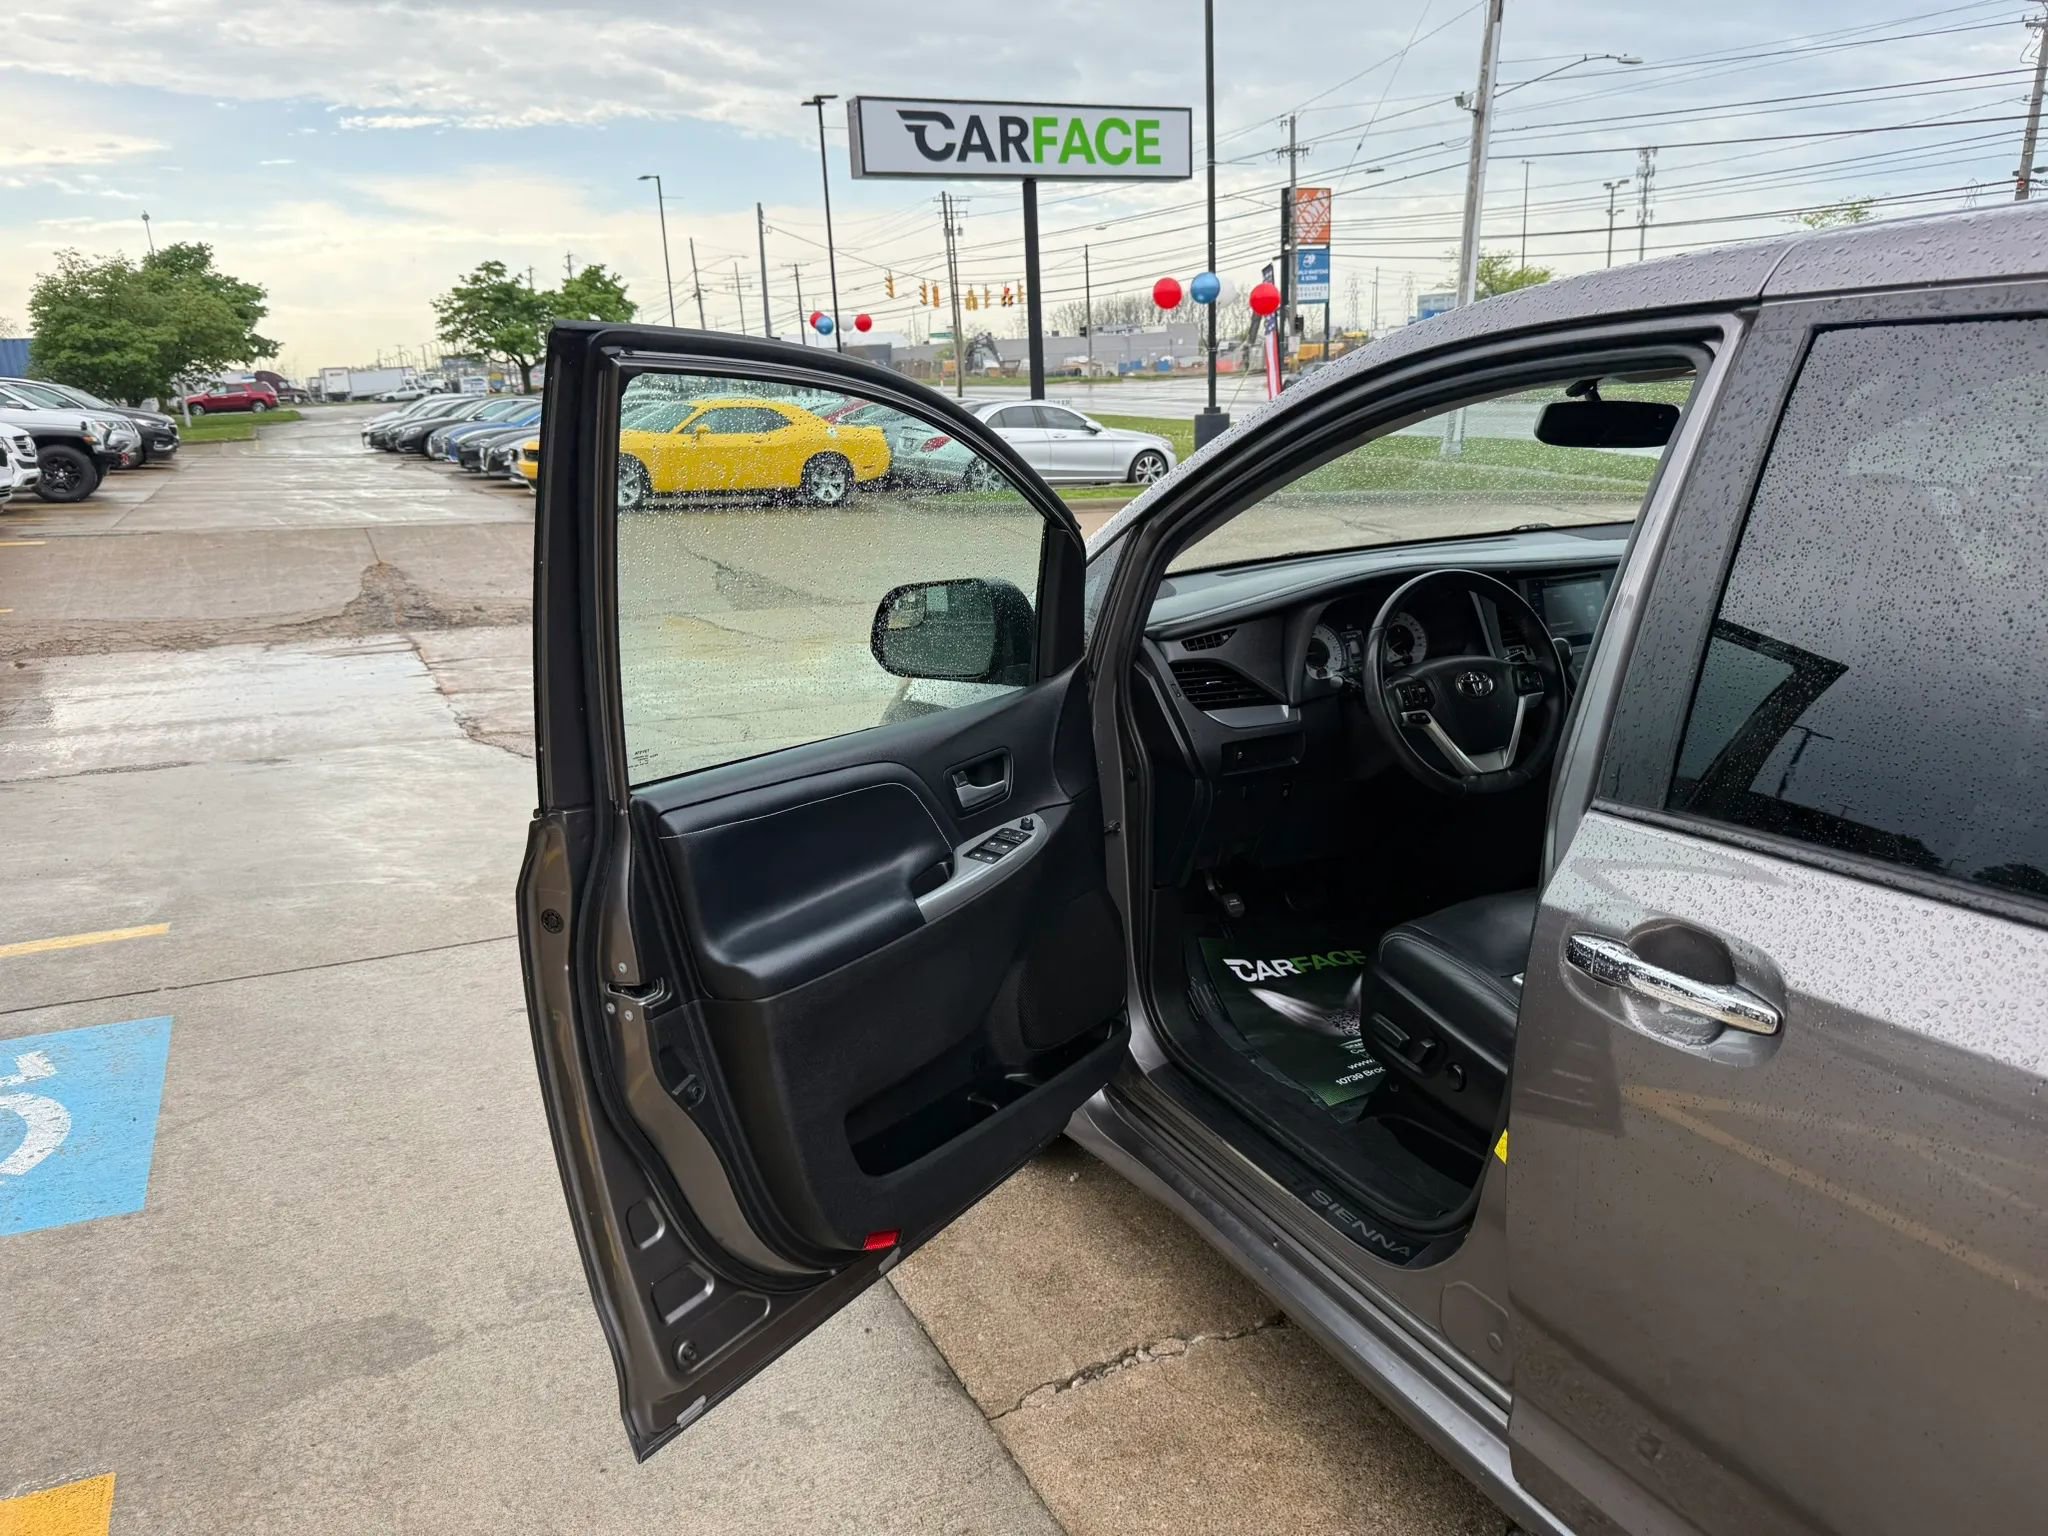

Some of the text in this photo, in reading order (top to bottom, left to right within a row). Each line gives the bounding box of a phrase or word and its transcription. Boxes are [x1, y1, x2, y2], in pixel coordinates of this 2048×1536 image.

[896, 109, 1161, 166] CARFACE
[1222, 950, 1367, 982] CARFACE
[1311, 1189, 1410, 1257] SIENNA
